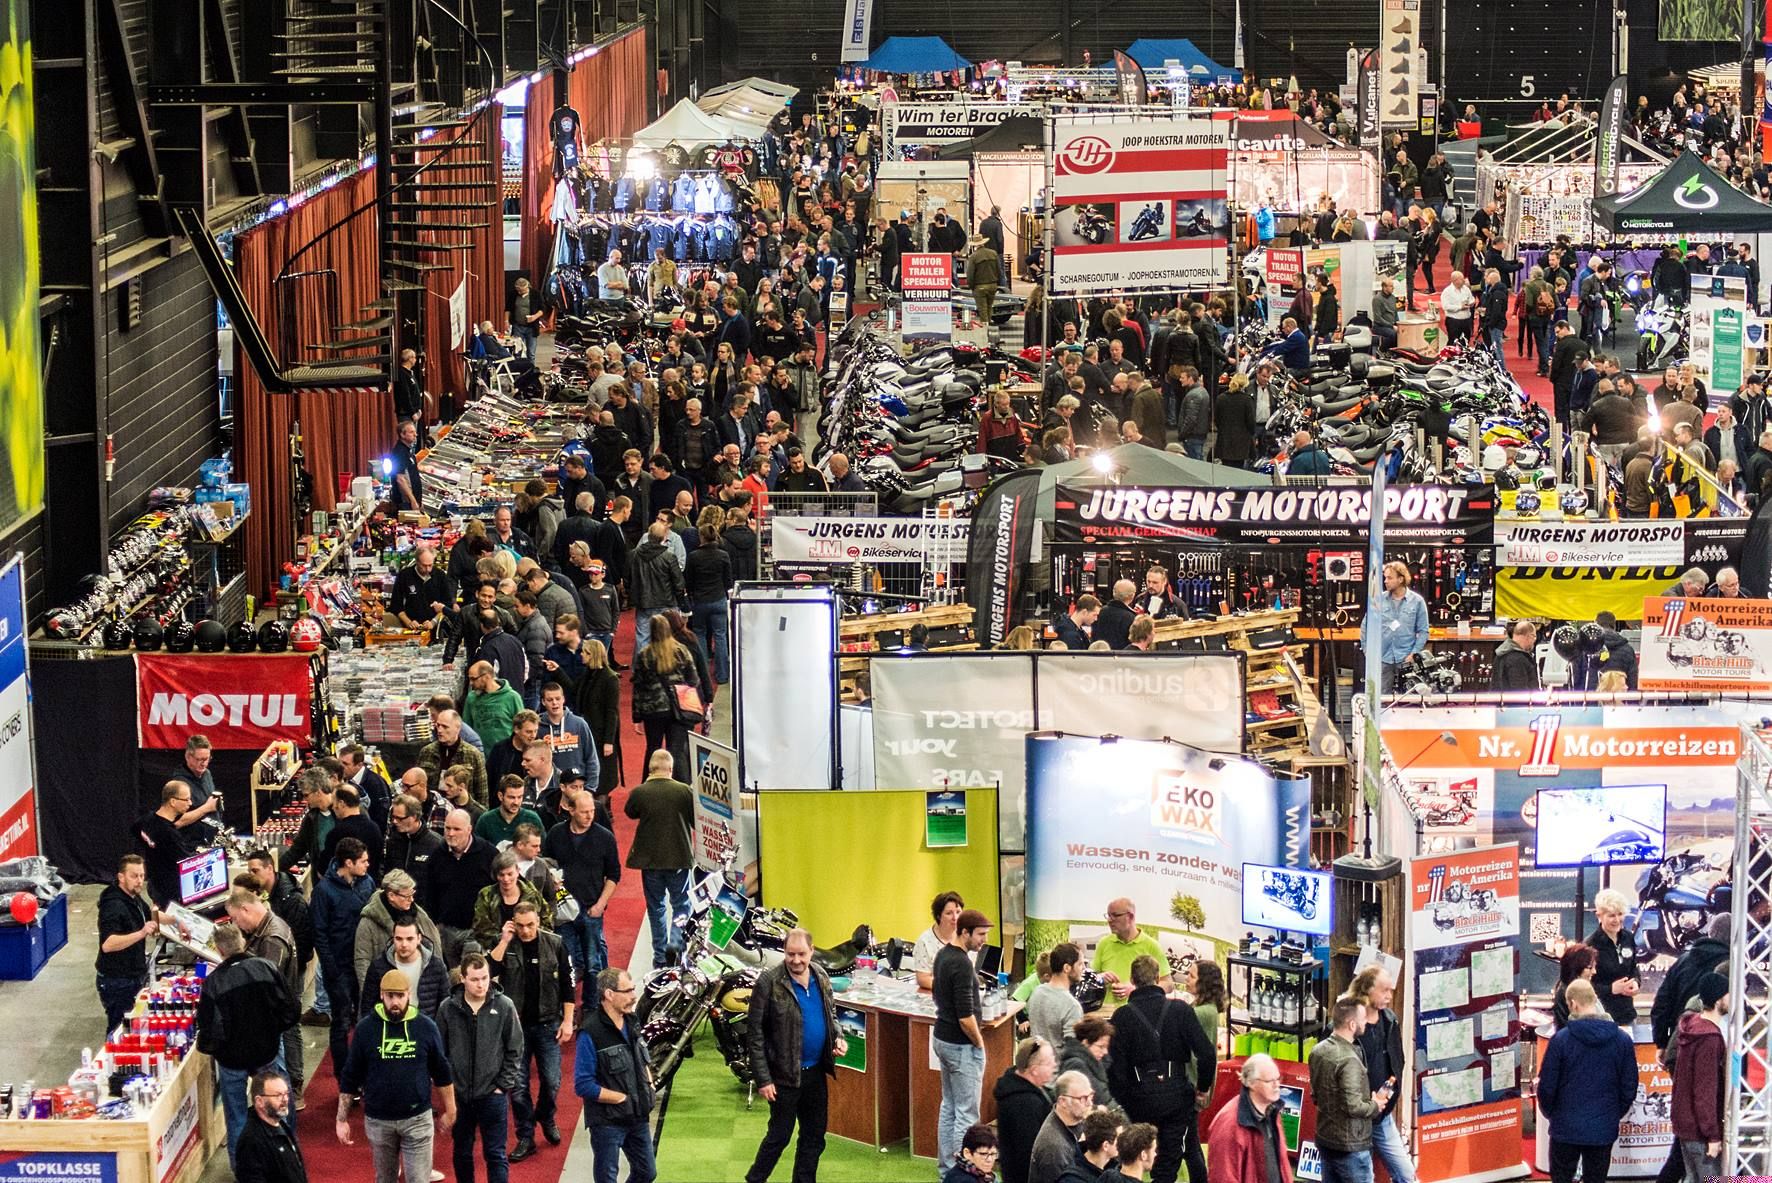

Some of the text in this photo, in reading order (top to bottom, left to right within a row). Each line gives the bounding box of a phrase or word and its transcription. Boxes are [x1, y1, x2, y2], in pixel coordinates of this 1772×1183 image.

[1520, 75, 1536, 97] 5
[1363, 70, 1377, 132] Vulcanet
[897, 109, 938, 123] Wim
[940, 109, 963, 123] ter
[926, 126, 974, 136] MOTOREN
[1607, 88, 1622, 178] MOTORCYCLES
[1121, 134, 1224, 149] JOOP HOEKSTRA MOTOREN
[911, 257, 942, 266] MOTOR
[1272, 252, 1297, 262] MOTOR
[908, 267, 945, 276] TRAILER
[1271, 262, 1299, 272] TRAILER
[904, 278, 950, 286] SPECIALIST
[1060, 272, 1119, 284] SCHARNEGOUTUM
[1127, 268, 1221, 281] JOOPHOEKSTRAMOTOREN.NL
[1267, 272, 1293, 282] SPECIAL
[904, 289, 949, 299] VERHUUR
[1079, 488, 1237, 524] JURGENS
[808, 522, 890, 539] JURGENS
[1507, 526, 1682, 544] JURGENS MOTORSPO
[993, 494, 1015, 587] MOTORSPORT
[1561, 551, 1624, 563] Bikeservice
[1689, 601, 1772, 614] Motorreizen
[1647, 614, 1664, 624] nr
[1715, 615, 1772, 627] Amerika
[1692, 656, 1754, 668] Black Hills
[147, 692, 304, 728] MOTUL
[1478, 735, 1522, 758] Nr.
[1563, 734, 1736, 757] Motorreizen
[703, 761, 728, 786] EKO
[701, 775, 729, 803] WAX
[1167, 785, 1215, 810] EKO
[1160, 803, 1214, 832] WAX
[1066, 843, 1150, 861] Wassen
[1156, 852, 1218, 872] zonder
[1066, 859, 1130, 873] Eenvoudig,
[1133, 863, 1157, 875] snel,
[1160, 866, 1208, 884] duurzaam
[1449, 860, 1514, 877] Motorreizen
[1417, 883, 1430, 893] nr
[1470, 871, 1514, 885] Amerika
[1620, 1121, 1656, 1136] Black
[1618, 1135, 1655, 1144] MOTOR
[17, 1162, 101, 1176] TOPKLASSE
[1300, 1160, 1312, 1172] JA
